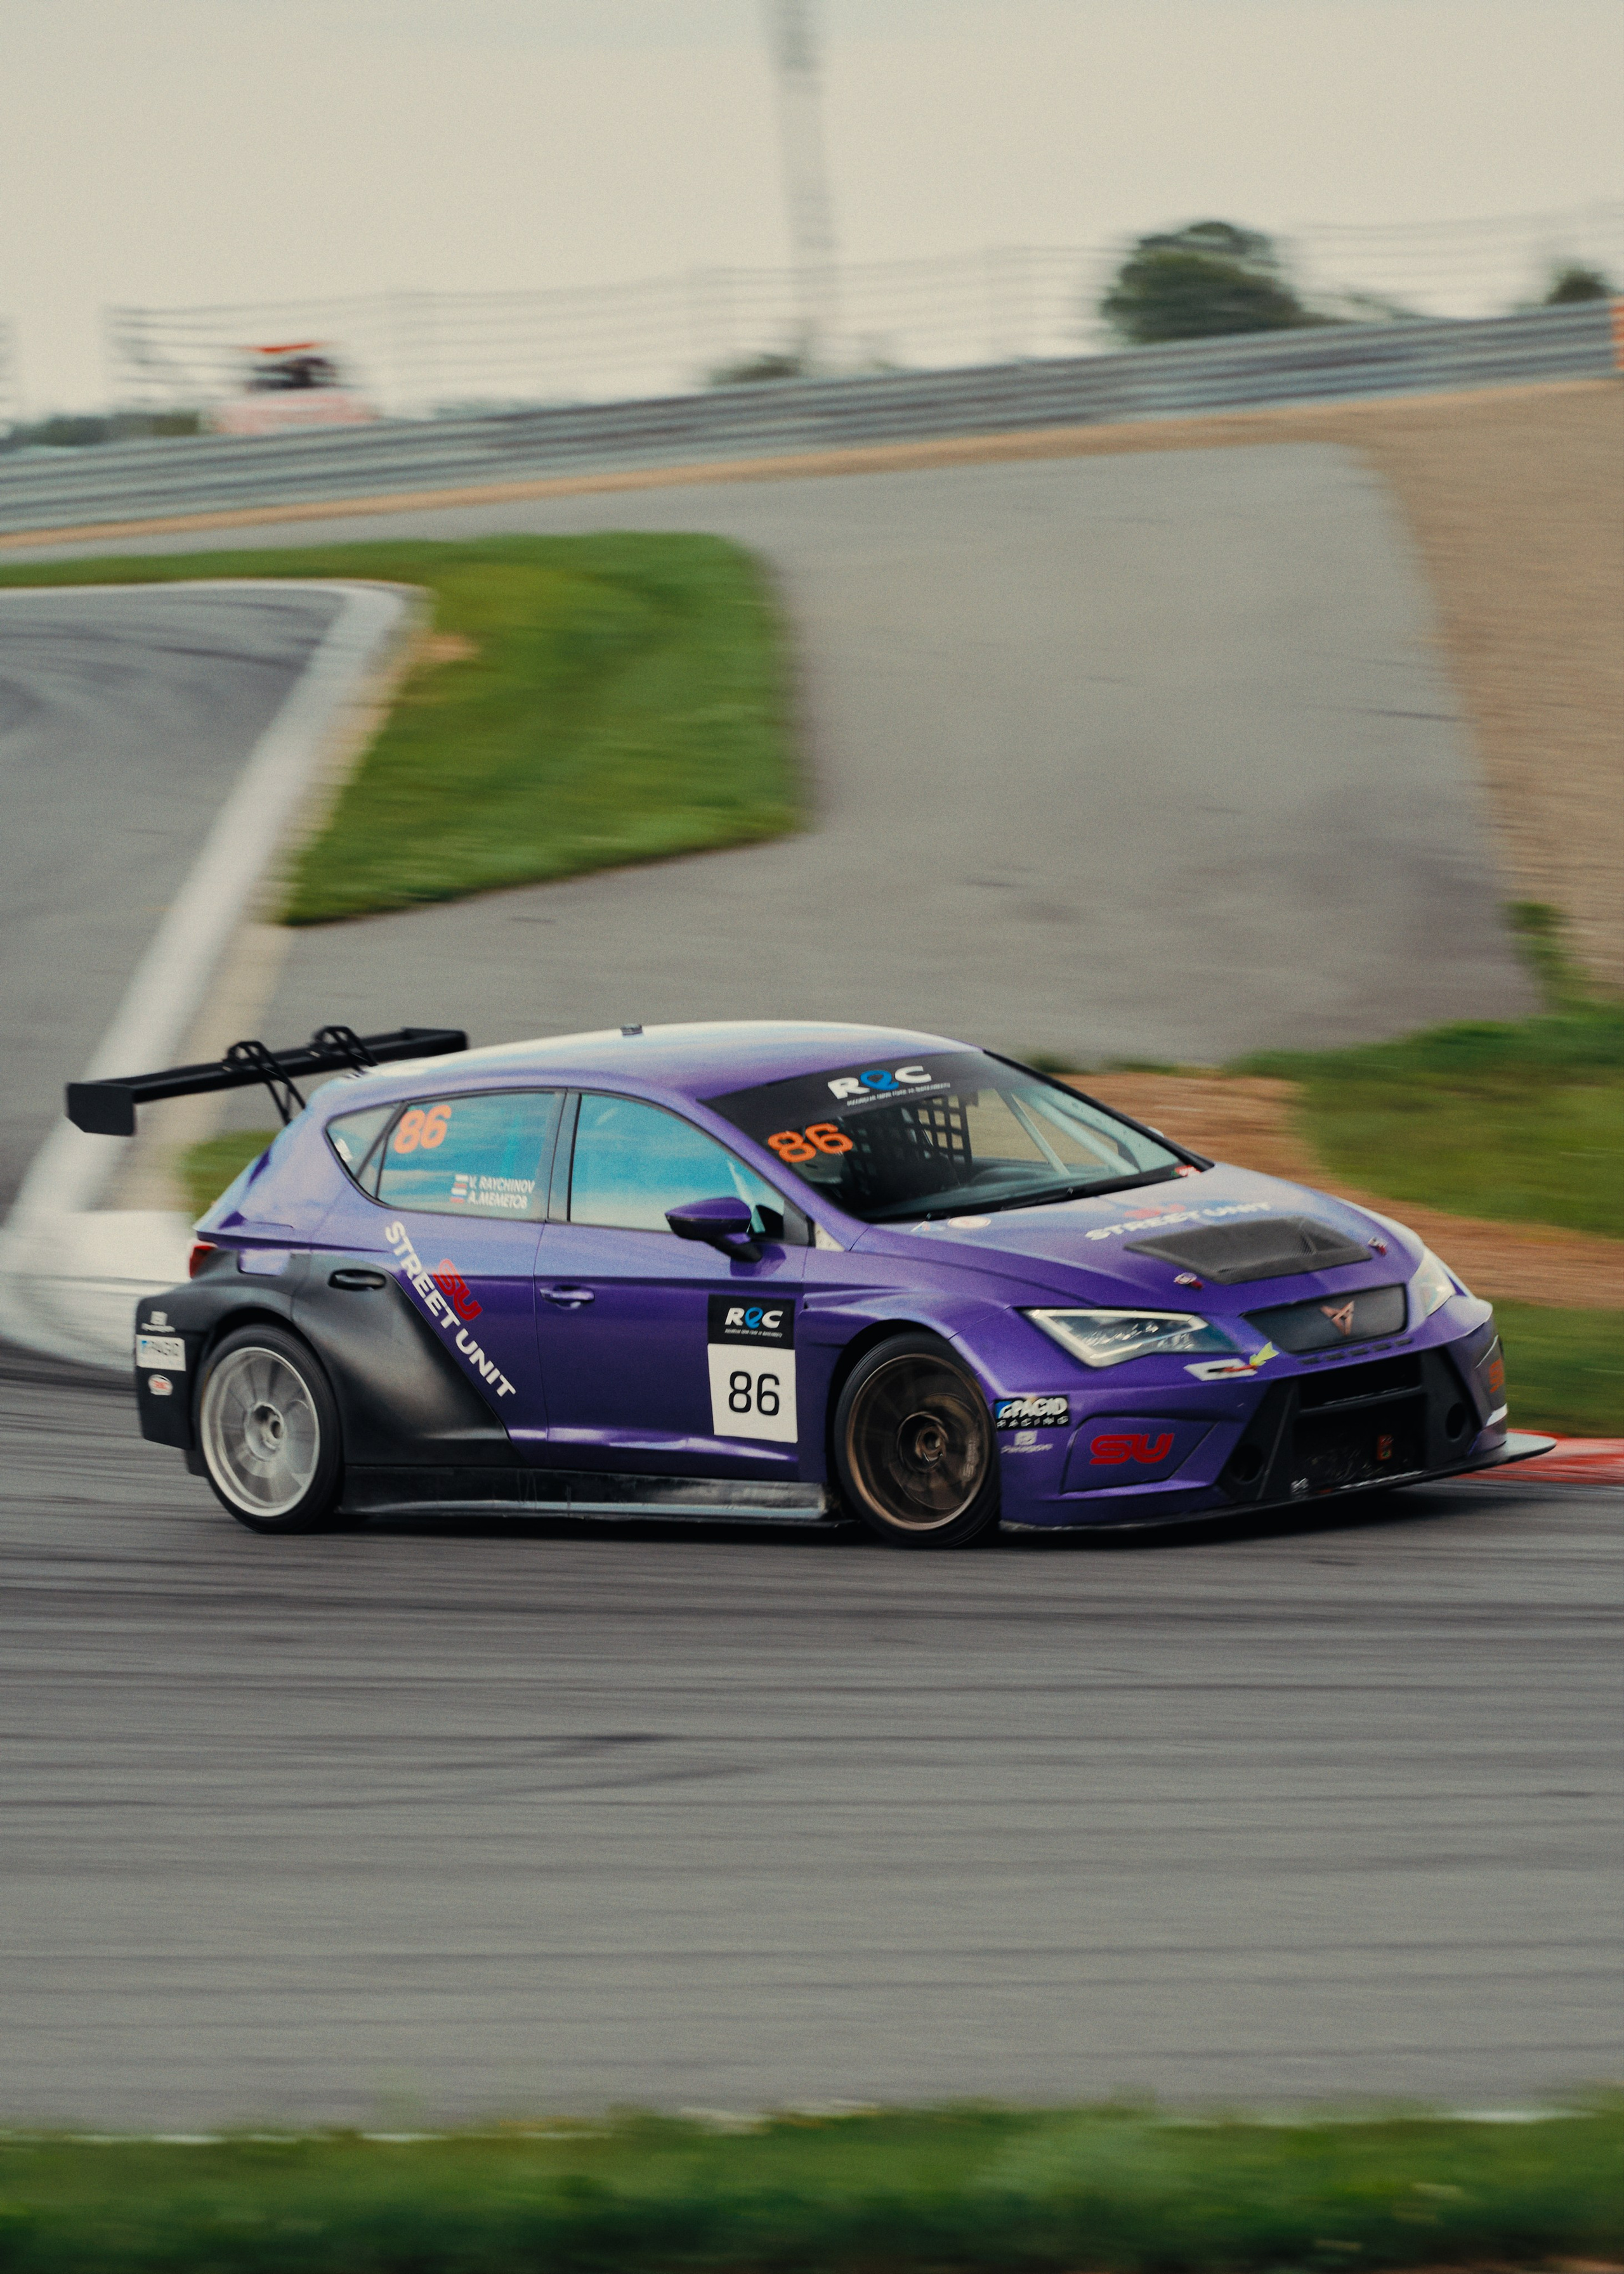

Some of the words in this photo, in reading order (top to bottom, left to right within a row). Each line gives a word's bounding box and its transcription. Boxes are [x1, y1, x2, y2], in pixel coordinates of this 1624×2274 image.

[393, 1104, 452, 1153] 86
[768, 1122, 853, 1162] 86
[384, 1220, 461, 1329] STREET
[455, 1328, 517, 1397] UNIT
[432, 1258, 483, 1321] SU
[728, 1370, 780, 1416] 86
[1089, 1433, 1175, 1465] SU
